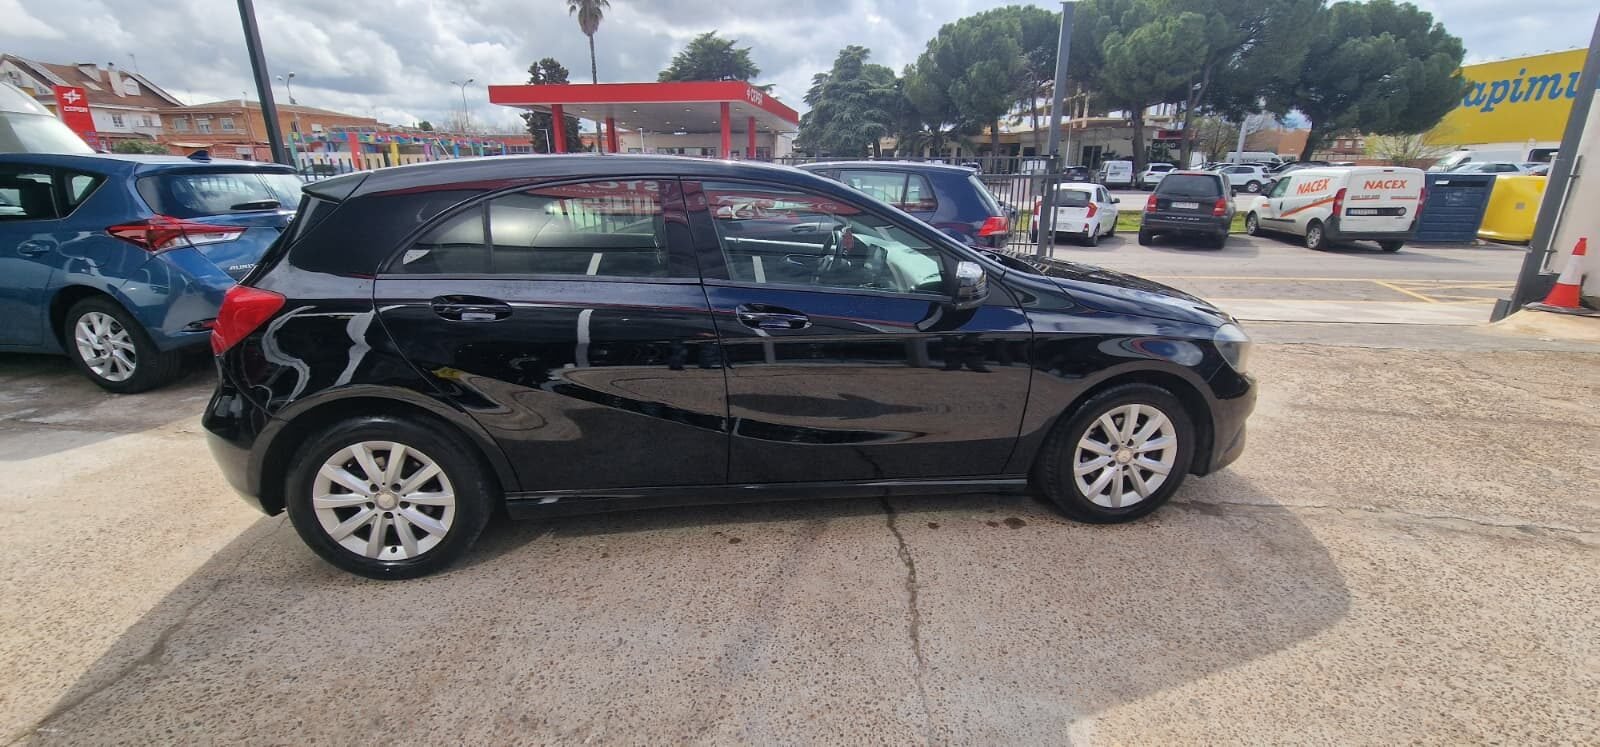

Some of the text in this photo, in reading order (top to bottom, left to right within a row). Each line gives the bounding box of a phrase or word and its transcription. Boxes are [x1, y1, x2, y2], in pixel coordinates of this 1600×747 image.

[1463, 68, 1580, 112] apimu
[1296, 178, 1330, 195] NACEX
[1363, 180, 1408, 190] NACEX
